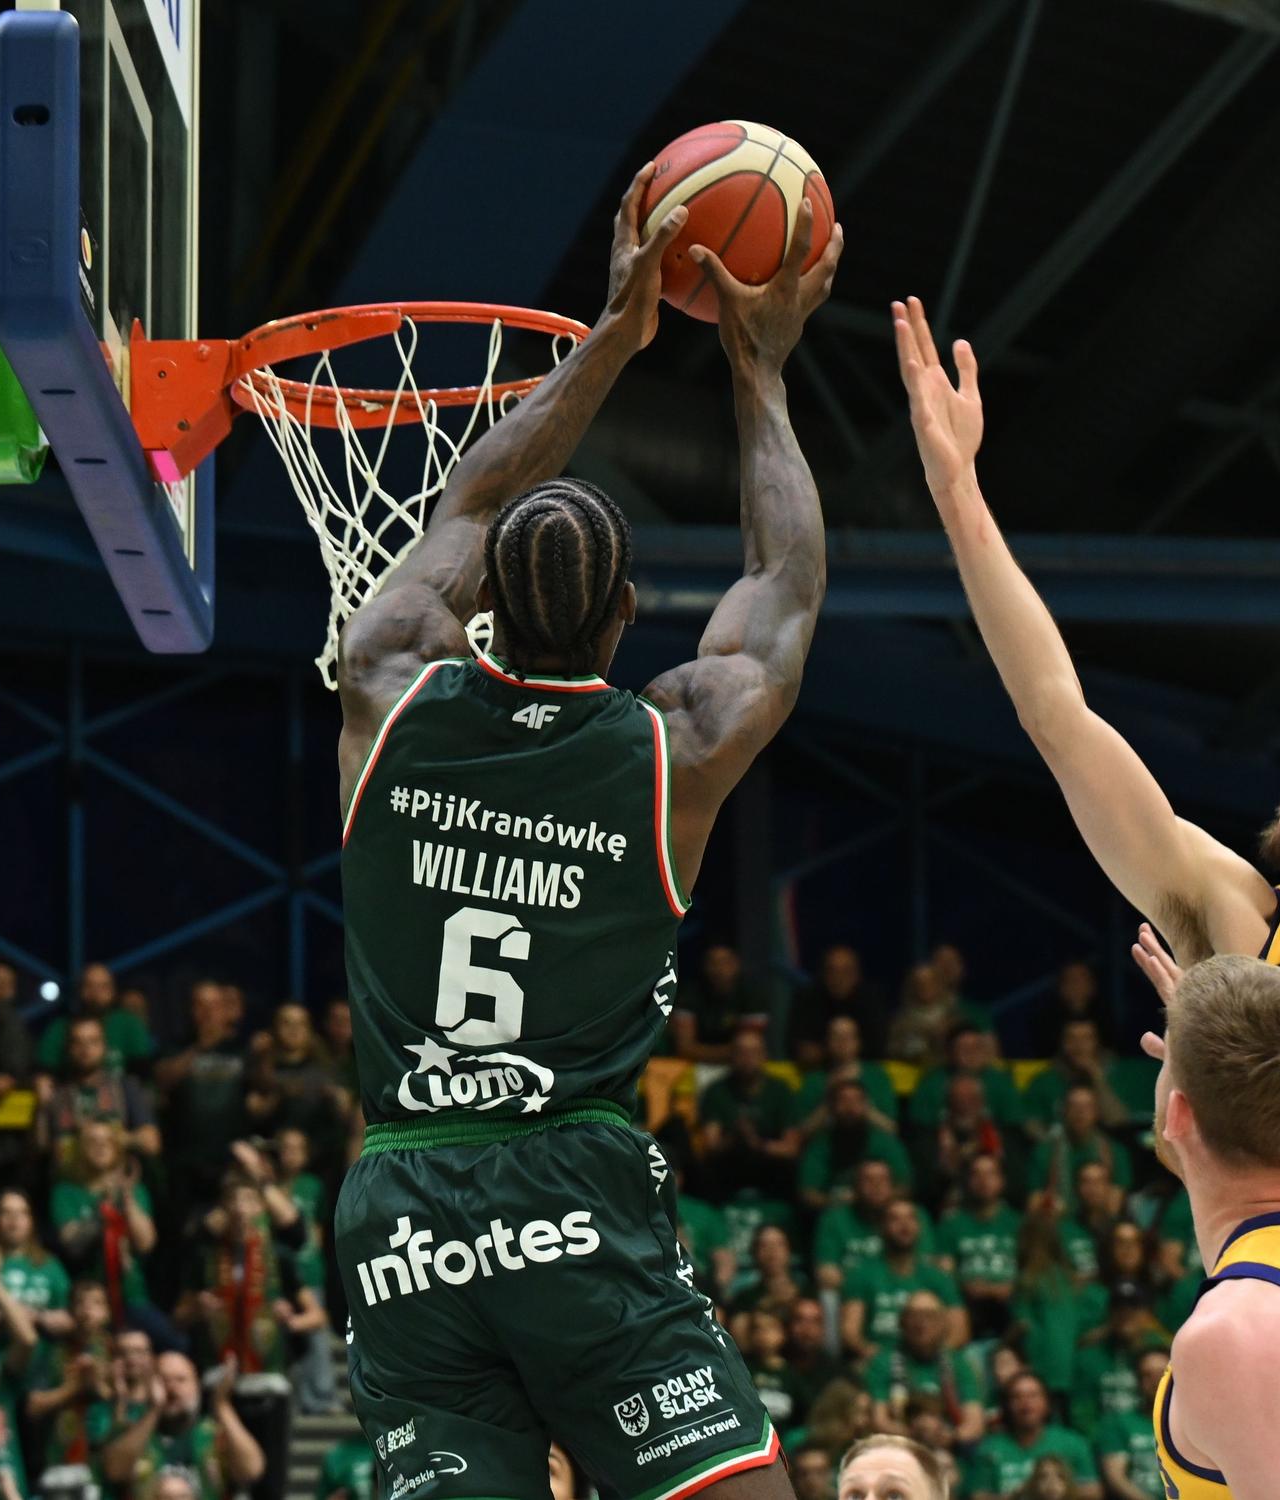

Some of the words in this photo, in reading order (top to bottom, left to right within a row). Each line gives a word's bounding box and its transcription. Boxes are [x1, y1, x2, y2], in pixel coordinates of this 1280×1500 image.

[511, 703, 561, 730] 4F
[390, 786, 627, 862] #PijKranówkę
[412, 840, 585, 910] WILLIAMS
[435, 907, 531, 1047] 6
[427, 1064, 524, 1108] LOTTO
[652, 1366, 714, 1402] DOLNY
[636, 1414, 741, 1466] dolnyslask.travel
